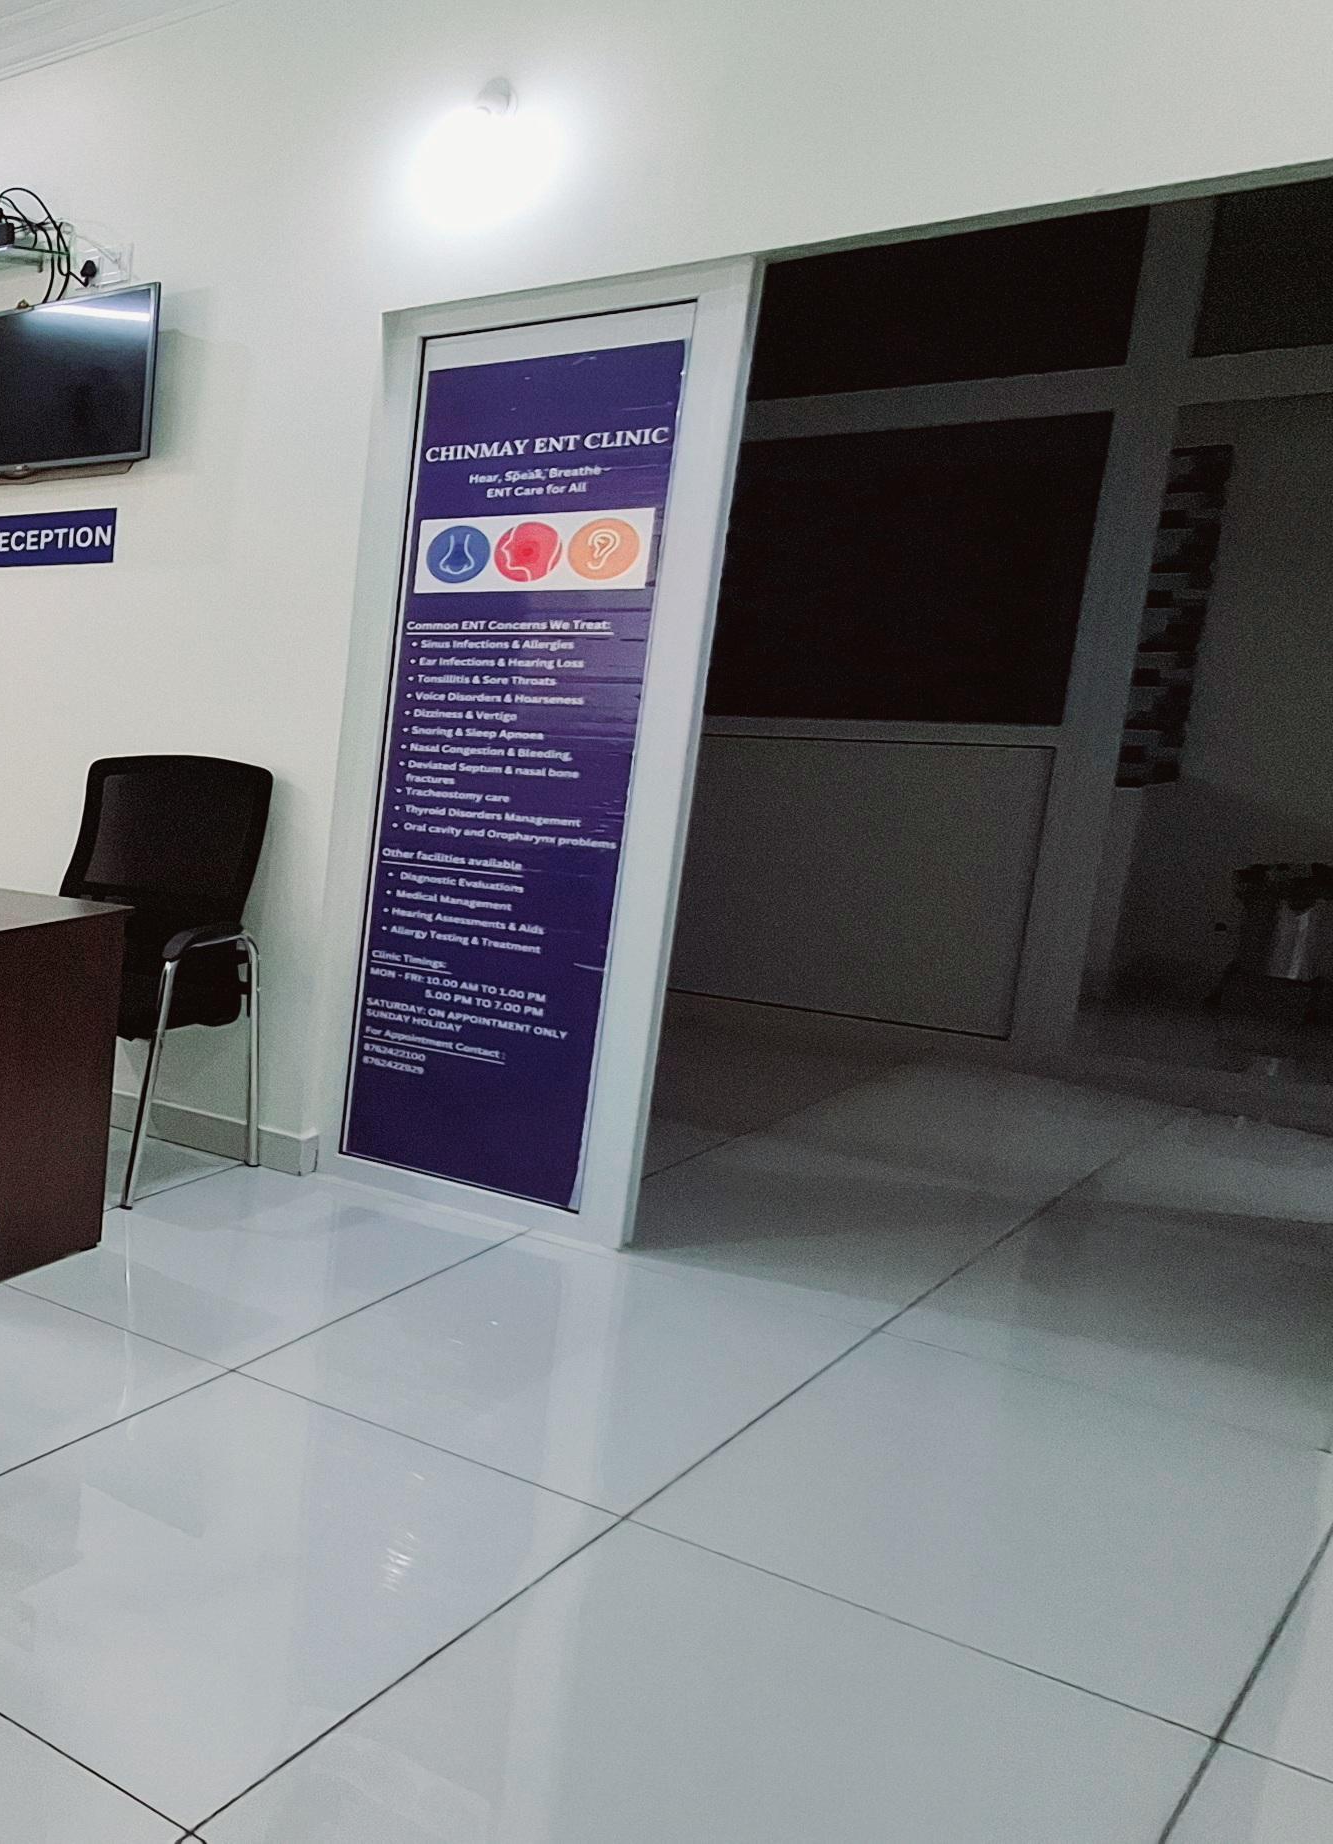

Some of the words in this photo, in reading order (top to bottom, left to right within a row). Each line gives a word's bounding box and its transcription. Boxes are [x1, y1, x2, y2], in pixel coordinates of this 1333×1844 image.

[425, 440, 529, 463] CHINMAY
[534, 436, 581, 455] ENT
[584, 427, 669, 449] CLINIC
[469, 474, 502, 484] Hear,
[504, 469, 546, 482] Speak,
[549, 465, 602, 478] Breathe
[486, 487, 512, 498] ENT
[514, 485, 543, 496] Care
[546, 484, 566, 494] for
[568, 482, 586, 492] All
[406, 621, 459, 631] Common
[461, 621, 485, 630] ENT
[488, 621, 547, 630] Concerns
[550, 620, 569, 630] We
[572, 620, 611, 630] Treat:
[421, 639, 450, 649] Sinus
[452, 640, 509, 649] Infections
[511, 640, 520, 649] &
[522, 640, 574, 651] Allergies
[419, 657, 437, 666] Ear
[439, 657, 495, 667] Infections
[498, 658, 506, 667] &
[508, 659, 554, 669] Hearing
[556, 659, 584, 668] Loss
[473, 676, 481, 684] &
[483, 676, 508, 685] Sore
[511, 676, 557, 686] Throats
[415, 692, 445, 701] Voice
[448, 693, 501, 702] Disorders
[504, 694, 513, 702] &
[515, 695, 584, 705] Hoarseness
[413, 709, 463, 719] Dizziness
[465, 711, 474, 719] &
[475, 711, 517, 723] Vertigo
[411, 726, 453, 738] Snoring
[455, 728, 463, 736] &
[465, 728, 496, 740] Sleep
[410, 744, 439, 753] Nasal
[442, 745, 507, 757] Congestion
[507, 748, 516, 757] &
[408, 760, 457, 772] Deviated
[459, 763, 502, 774] Septum
[504, 766, 513, 774] &
[515, 766, 546, 776] nasal
[548, 768, 580, 778] bone
[405, 774, 455, 785] fractures
[406, 787, 482, 802] Tracheostomy
[485, 794, 510, 802] care
[405, 804, 447, 817] Thyroid
[449, 808, 502, 821] Disorders
[505, 813, 581, 827] Management
[404, 822, 427, 832] Oral
[428, 826, 462, 837] cavity
[464, 828, 485, 837] and
[487, 830, 556, 843] Oropharynx
[558, 836, 617, 849] problems
[382, 848, 414, 858] Other
[417, 851, 465, 864] facilities
[468, 858, 523, 870] available
[400, 872, 456, 885] Diagnostic
[459, 878, 525, 893] Evaluations
[396, 889, 437, 902] Medical
[440, 894, 512, 911] Management
[392, 907, 433, 922] Hearing
[435, 912, 506, 930] Assessments
[508, 921, 517, 931] &
[519, 923, 544, 935] Aids
[390, 925, 427, 939] Allergy
[430, 930, 469, 945] Testing
[471, 936, 479, 945] &
[482, 937, 541, 954] Treatment
[372, 950, 402, 961] Clinic
[370, 967, 395, 978] MON
[426, 976, 458, 989] 10.00
[460, 982, 478, 992] AM
[482, 984, 497, 994] TO
[499, 987, 525, 998] 1.00
[527, 992, 546, 1002] PM
[454, 993, 472, 1005] PM
[475, 997, 492, 1008] TO
[494, 1000, 521, 1013] 7.00
[524, 1005, 544, 1016] PM
[366, 1008, 410, 1023] SUNDAY
[412, 1015, 462, 1032] HOLIDAY
[428, 1008, 445, 1018] ON
[447, 1011, 531, 1033] APPOINTMENT
[534, 1026, 567, 1039] ONLY
[366, 1026, 383, 1036] For
[384, 1030, 453, 1049] Appointment
[455, 1042, 500, 1058] Contact
